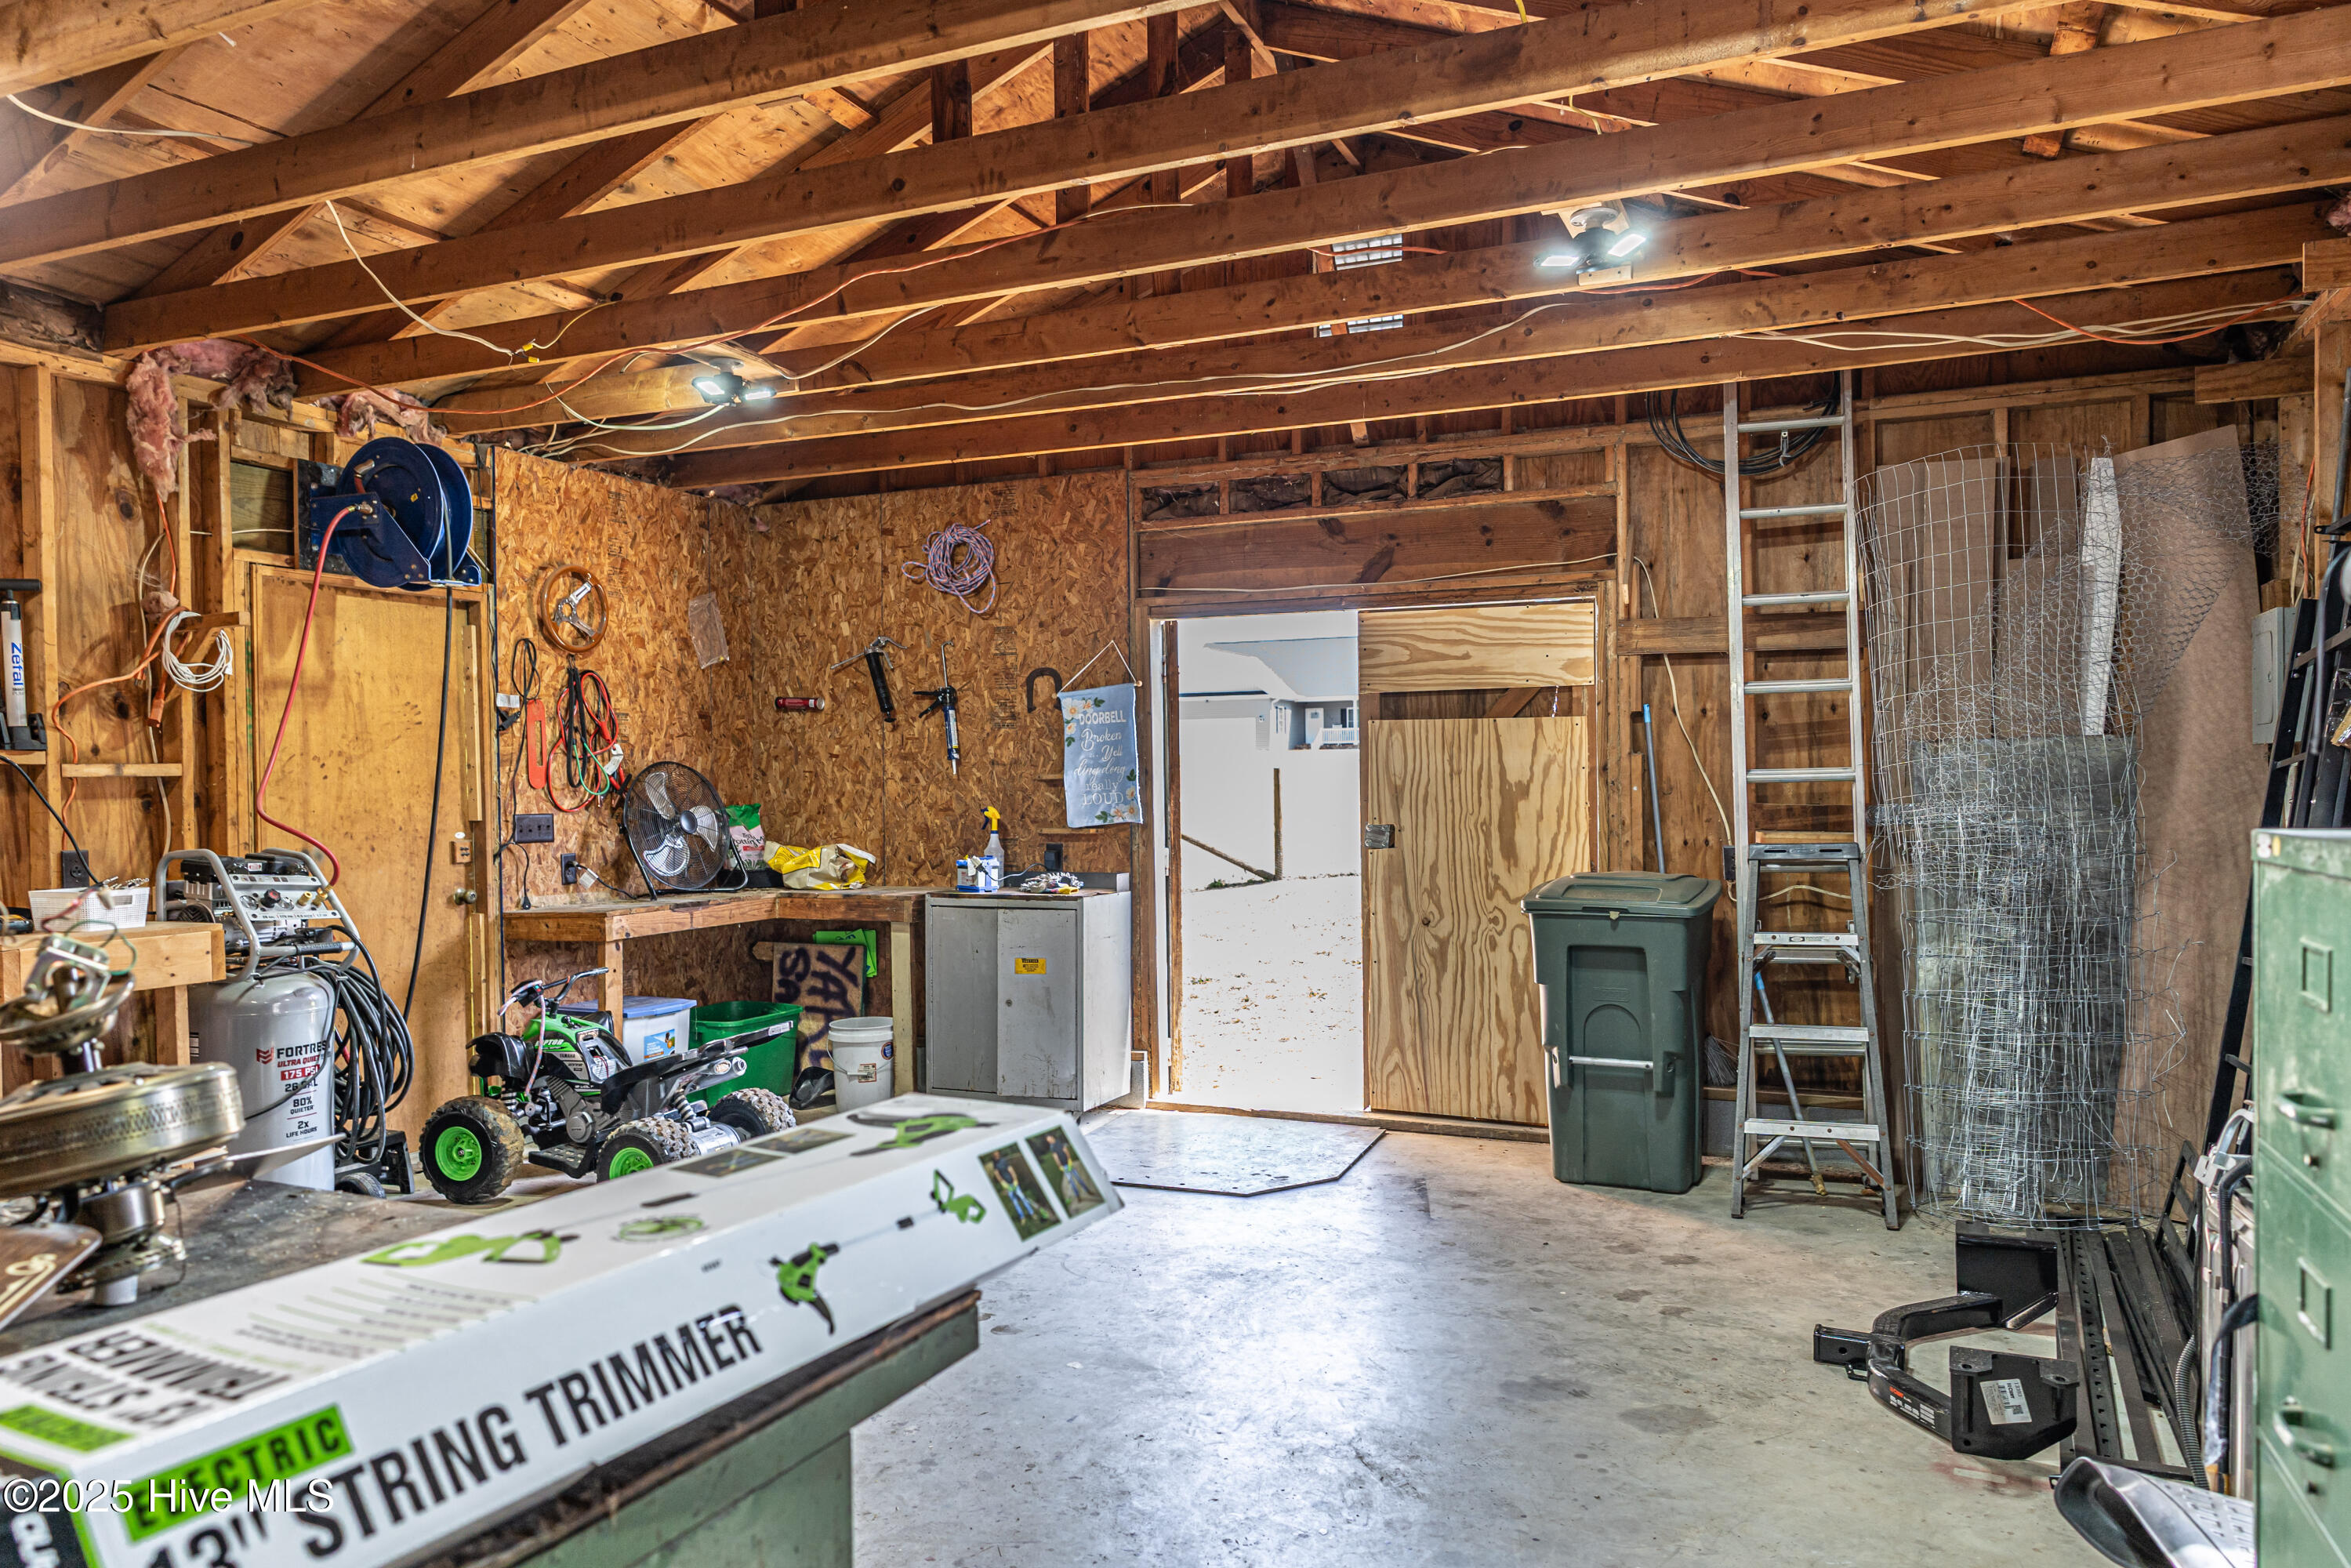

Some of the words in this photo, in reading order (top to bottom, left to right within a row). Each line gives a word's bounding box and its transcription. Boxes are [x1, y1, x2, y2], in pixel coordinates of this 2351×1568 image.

[11, 642, 24, 686] Zéfal
[1079, 710, 1127, 725] DOORBELL
[1080, 728, 1122, 751] Broken
[1101, 745, 1123, 761] Yell
[1073, 759, 1099, 783] ding
[1101, 757, 1126, 782] dong
[1085, 779, 1119, 792] really
[1083, 791, 1124, 806] LOUD
[734, 837, 758, 848] otting
[774, 947, 811, 1004] SA
[277, 1040, 330, 1058] FORTRES
[277, 1058, 300, 1067] ULTRA
[303, 1054, 320, 1064] QUIET
[284, 1069, 303, 1079] 175
[304, 1066, 319, 1076] PSI
[285, 1083, 299, 1092] 26
[292, 1096, 313, 1107] 80%
[290, 1105, 314, 1115] QUIETER
[286, 1129, 299, 1138] LIFE
[299, 1126, 317, 1136] HOURS
[298, 1121, 309, 1130] 2x
[294, 1403, 528, 1556] STRING
[526, 1304, 764, 1448] TRIMMER
[132, 1414, 343, 1529] ELECTRIC
